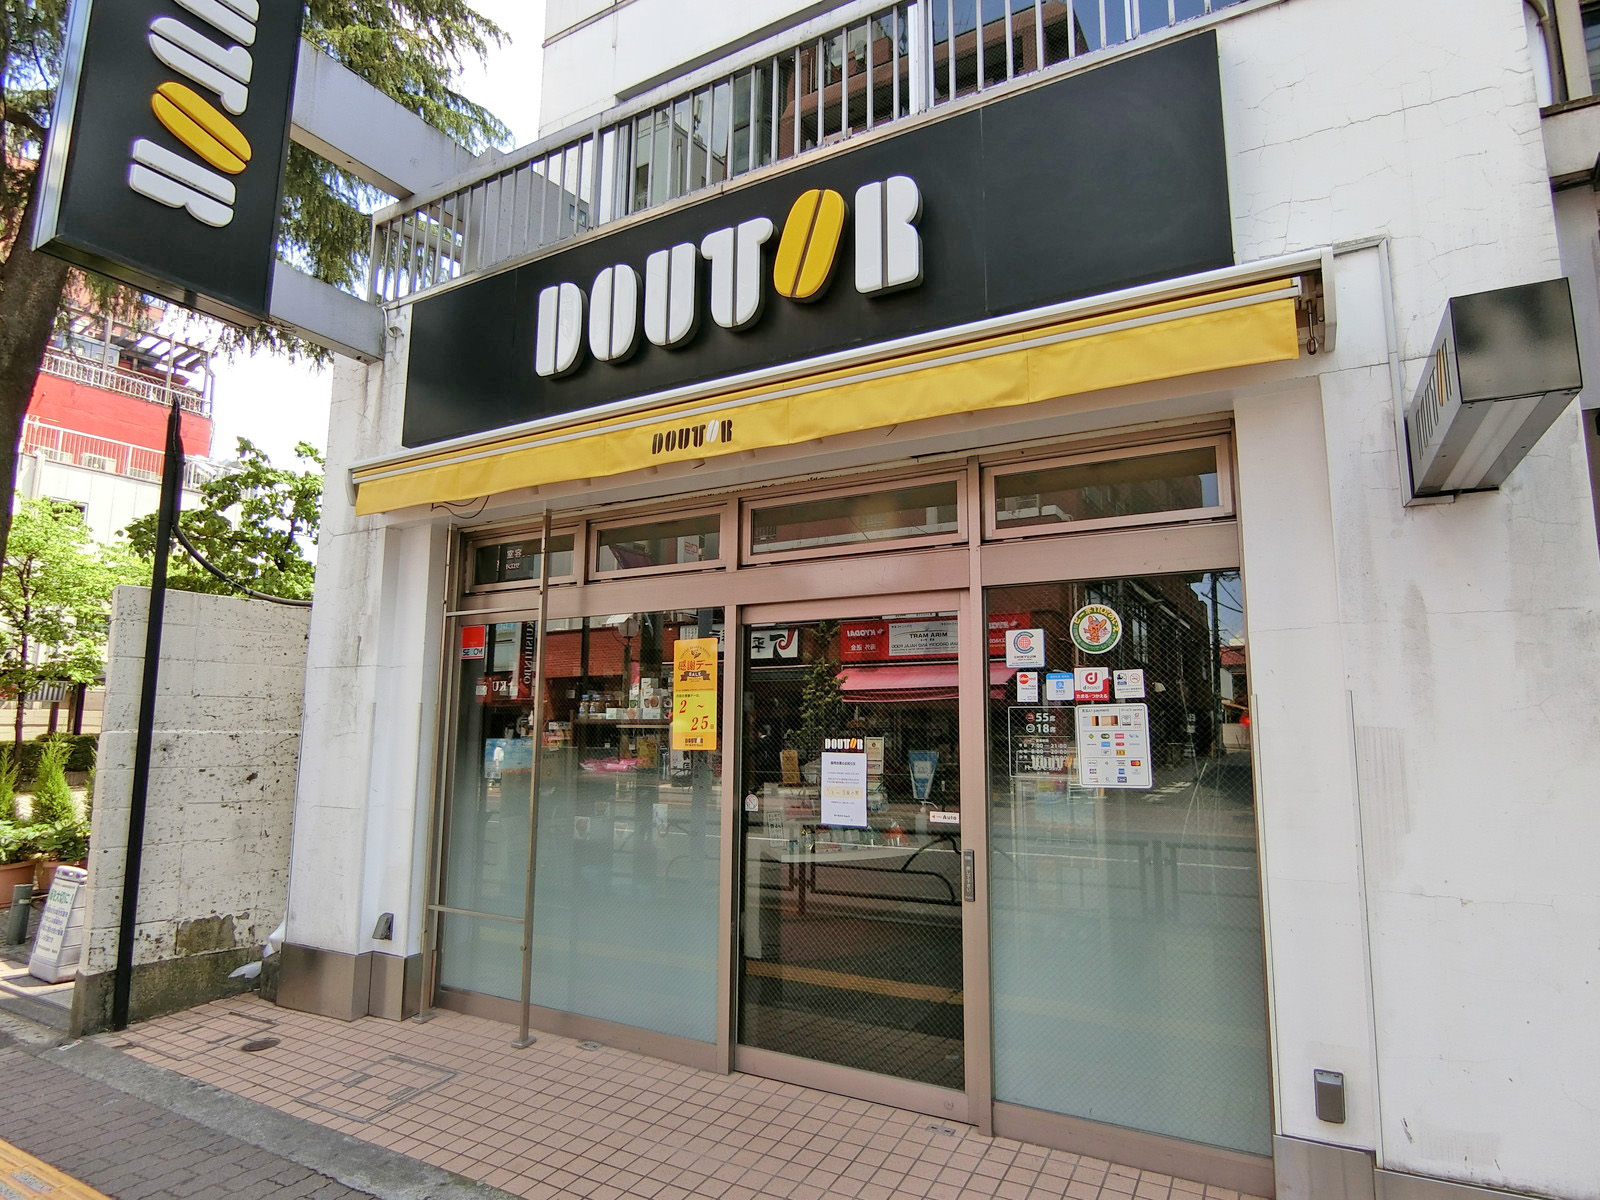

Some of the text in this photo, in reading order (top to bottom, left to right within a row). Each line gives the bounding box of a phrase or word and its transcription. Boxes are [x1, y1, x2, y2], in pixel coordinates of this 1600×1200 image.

[535, 175, 922, 378] DOUTOR
[1416, 338, 1452, 460] DOUTOR
[652, 420, 733, 454] DOUTOR
[462, 648, 483, 656] SEOM
[678, 659, 713, 671] 感謝デー
[679, 699, 687, 714] 2
[825, 738, 863, 750] DOUTOR
